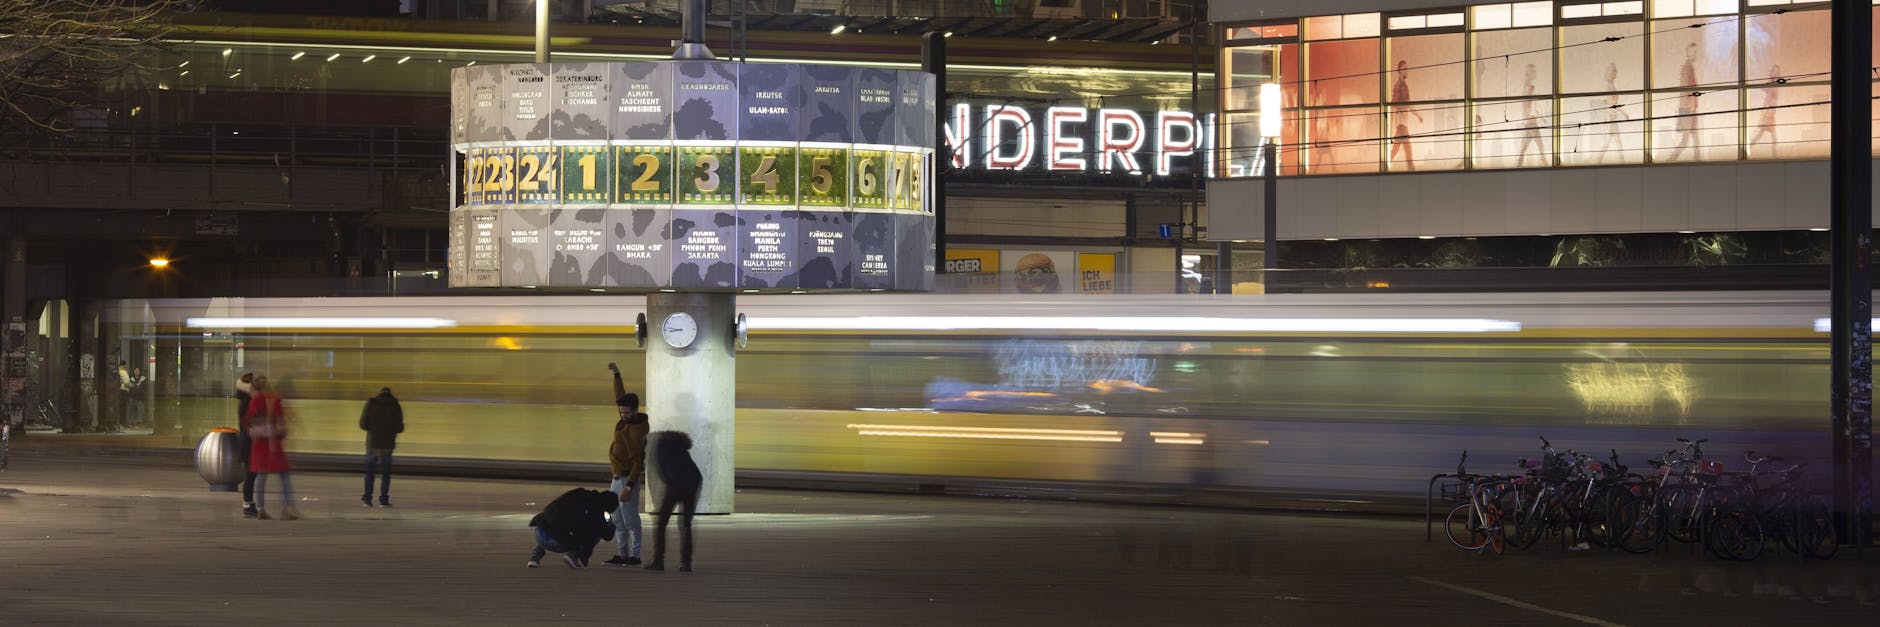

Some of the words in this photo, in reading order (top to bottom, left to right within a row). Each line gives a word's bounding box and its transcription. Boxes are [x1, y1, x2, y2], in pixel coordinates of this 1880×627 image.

[756, 91, 783, 99] IRKUTSK
[618, 105, 662, 113] NOWOSIBIRSK
[485, 155, 514, 191] 23
[519, 154, 557, 191] 24
[578, 154, 596, 190] 1
[631, 154, 660, 191] 2
[694, 154, 720, 193] 3
[750, 156, 780, 193] 4
[811, 157, 833, 194] 5
[858, 158, 877, 196] 6
[754, 237, 781, 245] MANILA
[817, 238, 835, 246] TOKYO
[616, 243, 645, 251] RANGUN
[626, 251, 652, 259] DHAKA
[750, 252, 786, 260] HONGKONG
[743, 259, 765, 267] KUALA
[1082, 270, 1100, 281] ICH
[1082, 280, 1112, 292] LIEBE
